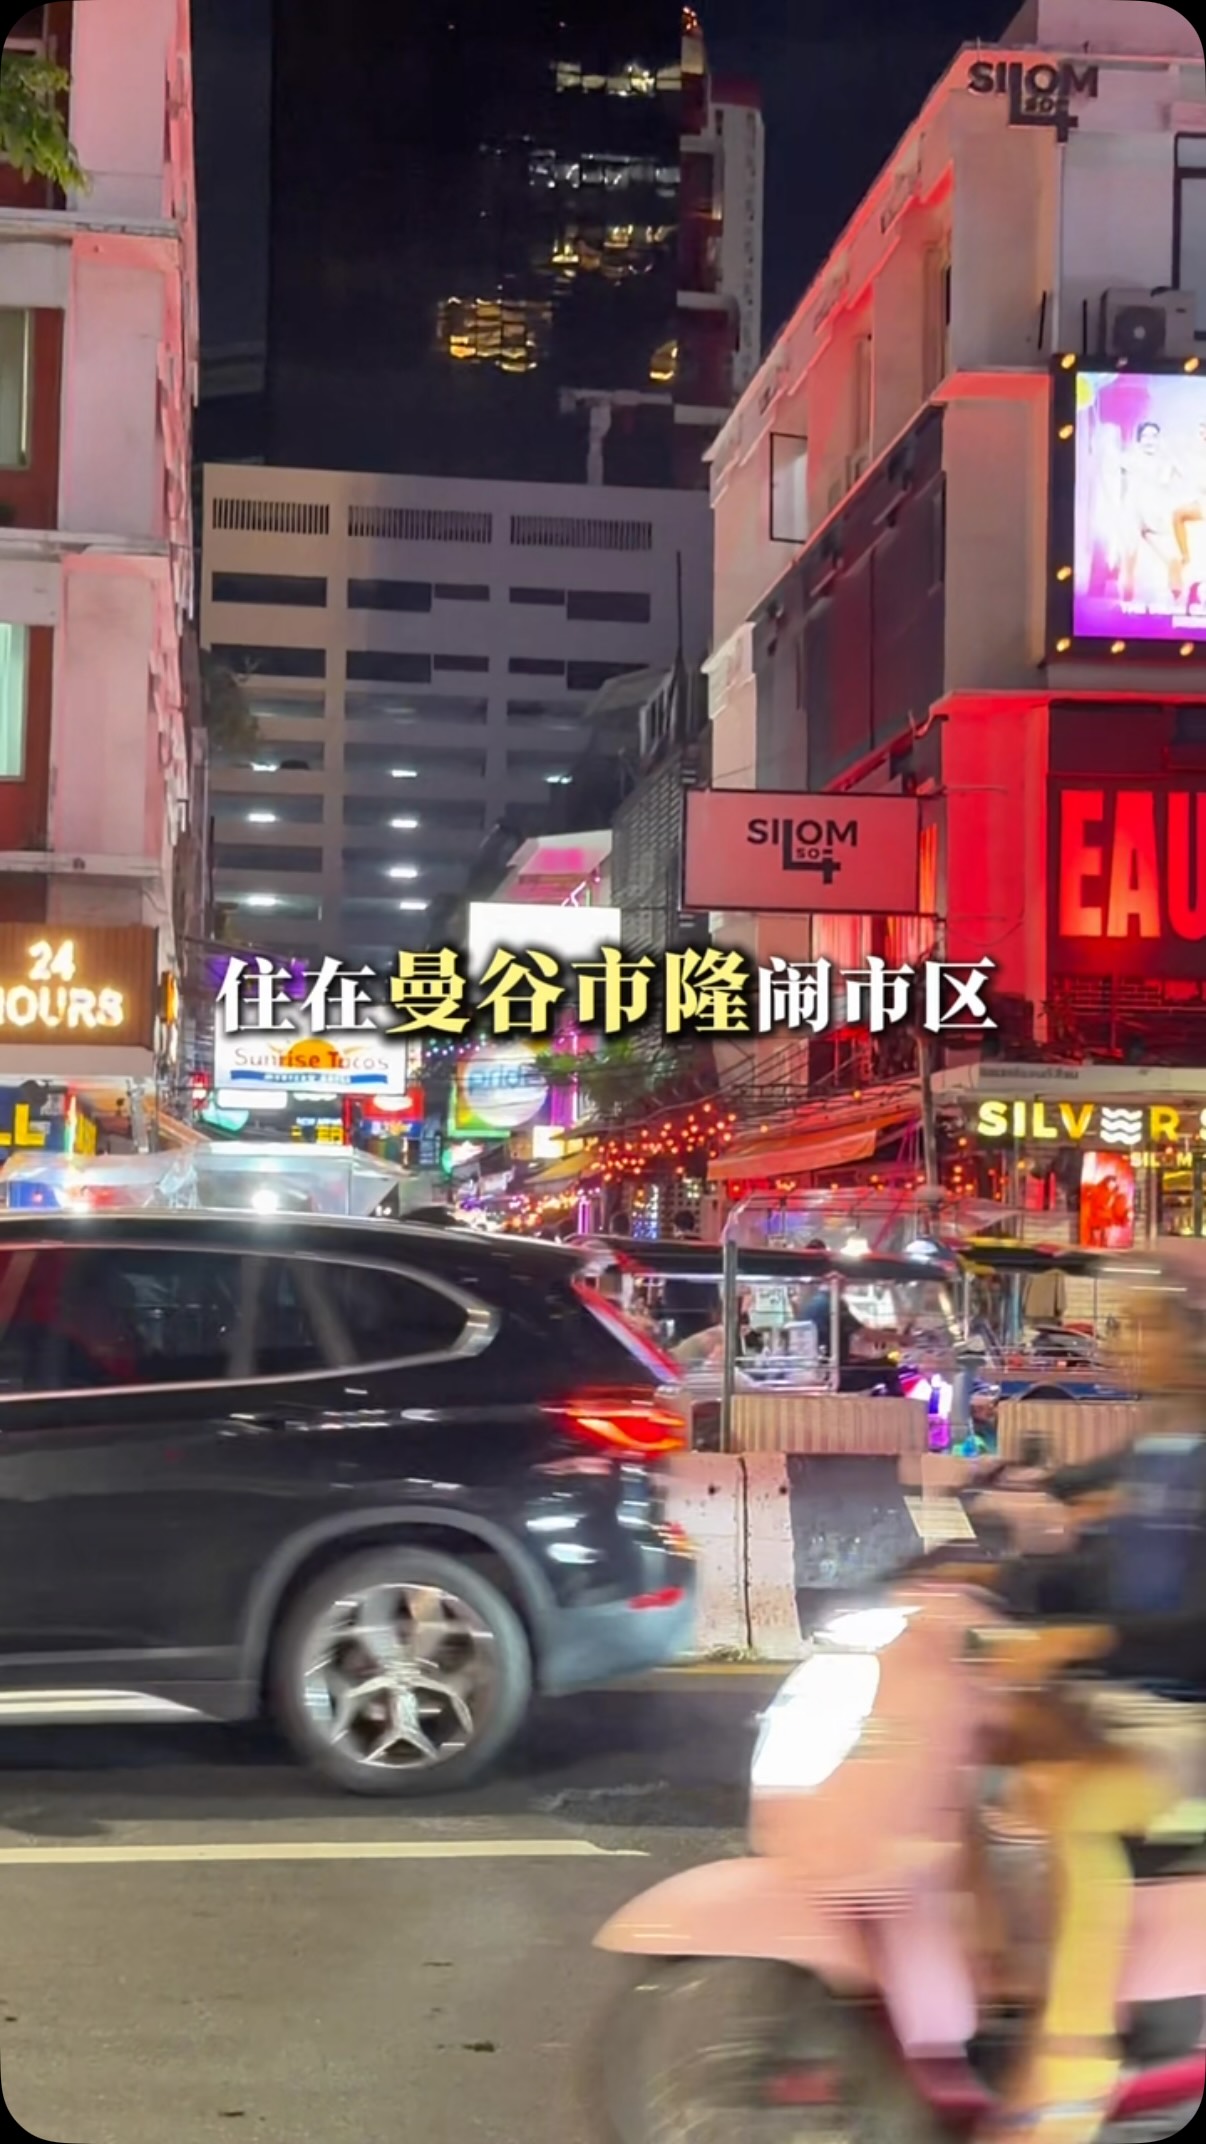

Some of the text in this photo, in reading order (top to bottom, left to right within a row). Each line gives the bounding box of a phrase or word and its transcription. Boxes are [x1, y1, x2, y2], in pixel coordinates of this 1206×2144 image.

[968, 61, 1099, 128] SILOM
[747, 818, 858, 871] SILOM
[1059, 790, 1206, 942] EAU
[28, 939, 76, 982] 24
[0, 985, 124, 1029] OURS
[234, 1047, 389, 1071] Sunrise Tacos
[0, 1103, 46, 1147] L
